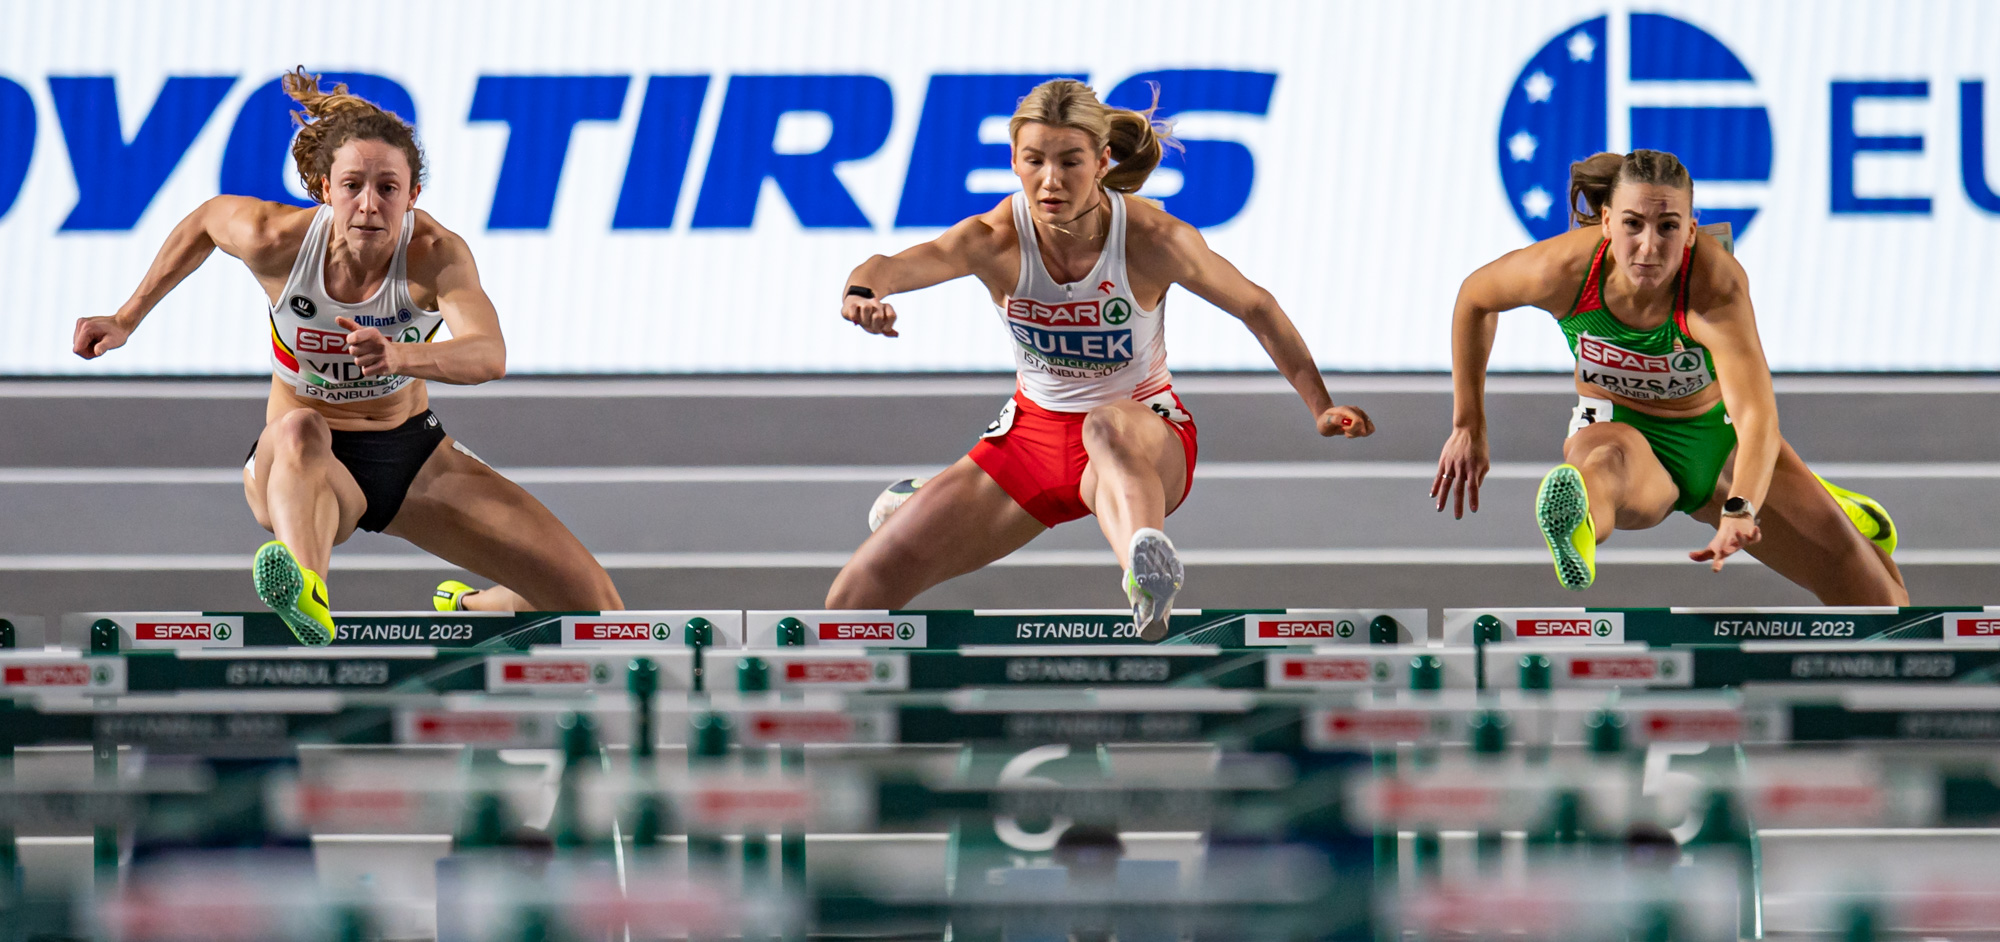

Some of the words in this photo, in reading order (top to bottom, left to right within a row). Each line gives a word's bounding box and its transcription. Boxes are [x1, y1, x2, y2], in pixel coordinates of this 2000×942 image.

[0, 72, 416, 231] YO
[467, 70, 1277, 231] TIRES
[354, 314, 397, 327] Allianz
[1009, 301, 1098, 324] SPAR
[1012, 324, 1132, 359] SULEK
[1582, 341, 1668, 371] SPAR
[1023, 351, 1091, 379] ISTANBUL
[306, 384, 378, 401] ISTANBUL
[154, 625, 210, 639] SPAR
[334, 624, 424, 640] ISTANBUL
[429, 624, 473, 640] 2023
[593, 625, 649, 639] SPAR
[837, 624, 894, 639] SPAR
[1016, 622, 1109, 639] ISTANBUL
[1112, 622, 1142, 639] 20
[1277, 622, 1333, 637] SPAR
[1534, 621, 1590, 635] SPAR
[1714, 620, 1805, 637] ISTANBUL
[1811, 620, 1855, 637] 2023
